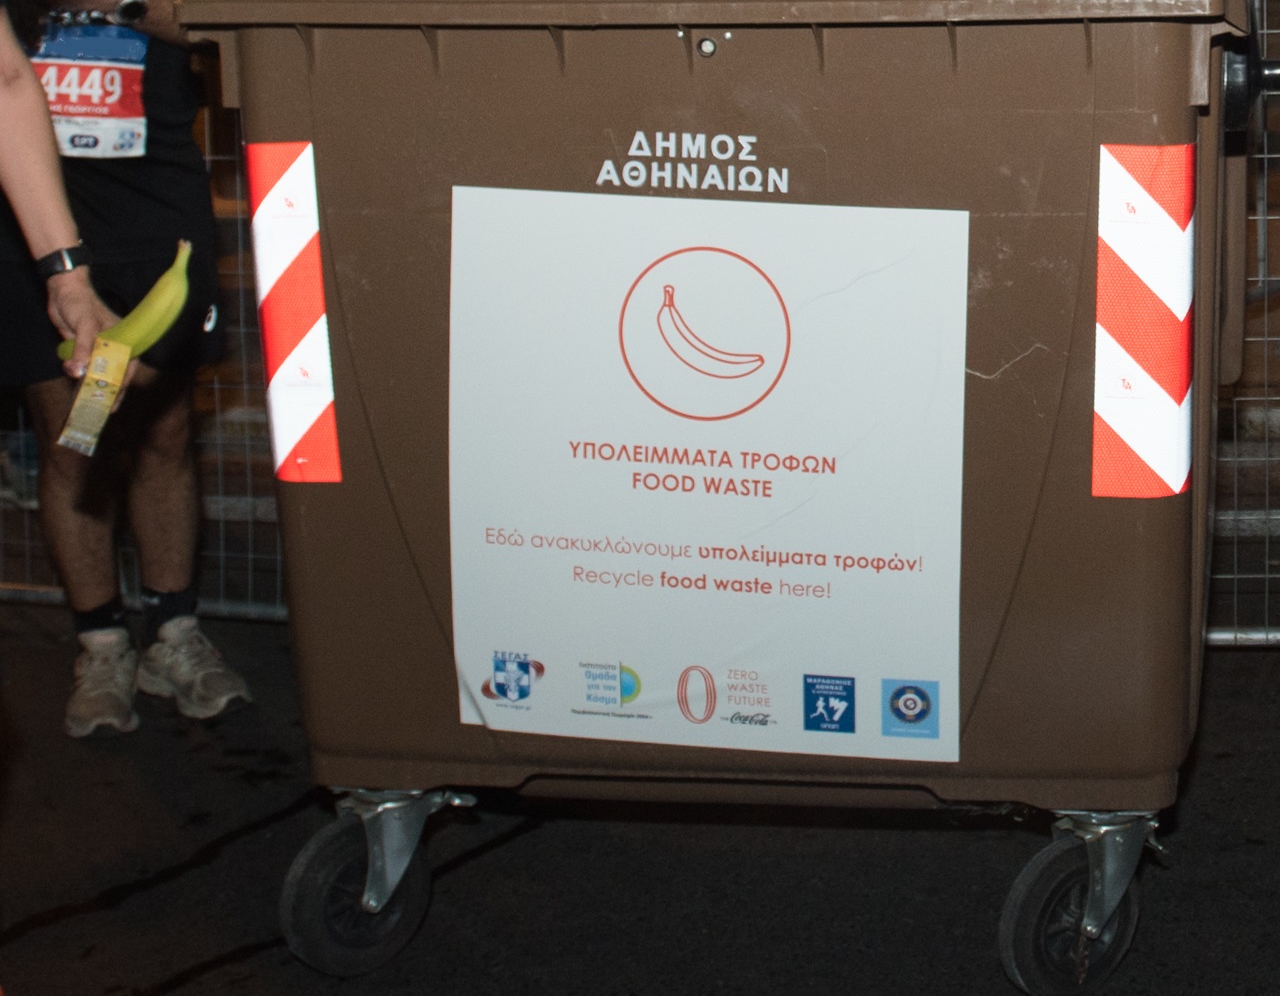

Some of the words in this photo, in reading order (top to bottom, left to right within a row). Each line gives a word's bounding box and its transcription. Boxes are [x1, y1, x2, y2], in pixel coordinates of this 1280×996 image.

[41, 65, 123, 104] 4449
[628, 130, 758, 161] ΔΗΜΟΣ
[596, 159, 789, 193] ΑΘΗΝΑΙΩΝ
[569, 440, 733, 469] ΥΠΟΛΕΙΜΜΑΤΑ
[739, 450, 837, 475] ΤΡΟΦΩΝ
[631, 471, 697, 494] FOOD
[702, 476, 773, 499] WASTE
[484, 526, 525, 547] Εδώ
[530, 534, 692, 561] ανακυκλώνουμε
[697, 544, 827, 568] υπολείμματα
[833, 552, 923, 574] τροφών!
[572, 565, 654, 588] Recycle
[659, 571, 707, 590] food
[713, 577, 773, 595] waste
[779, 578, 832, 599] here!
[727, 669, 759, 681] ZERO
[727, 683, 768, 694] WASTE
[727, 696, 771, 707] FUTURE
